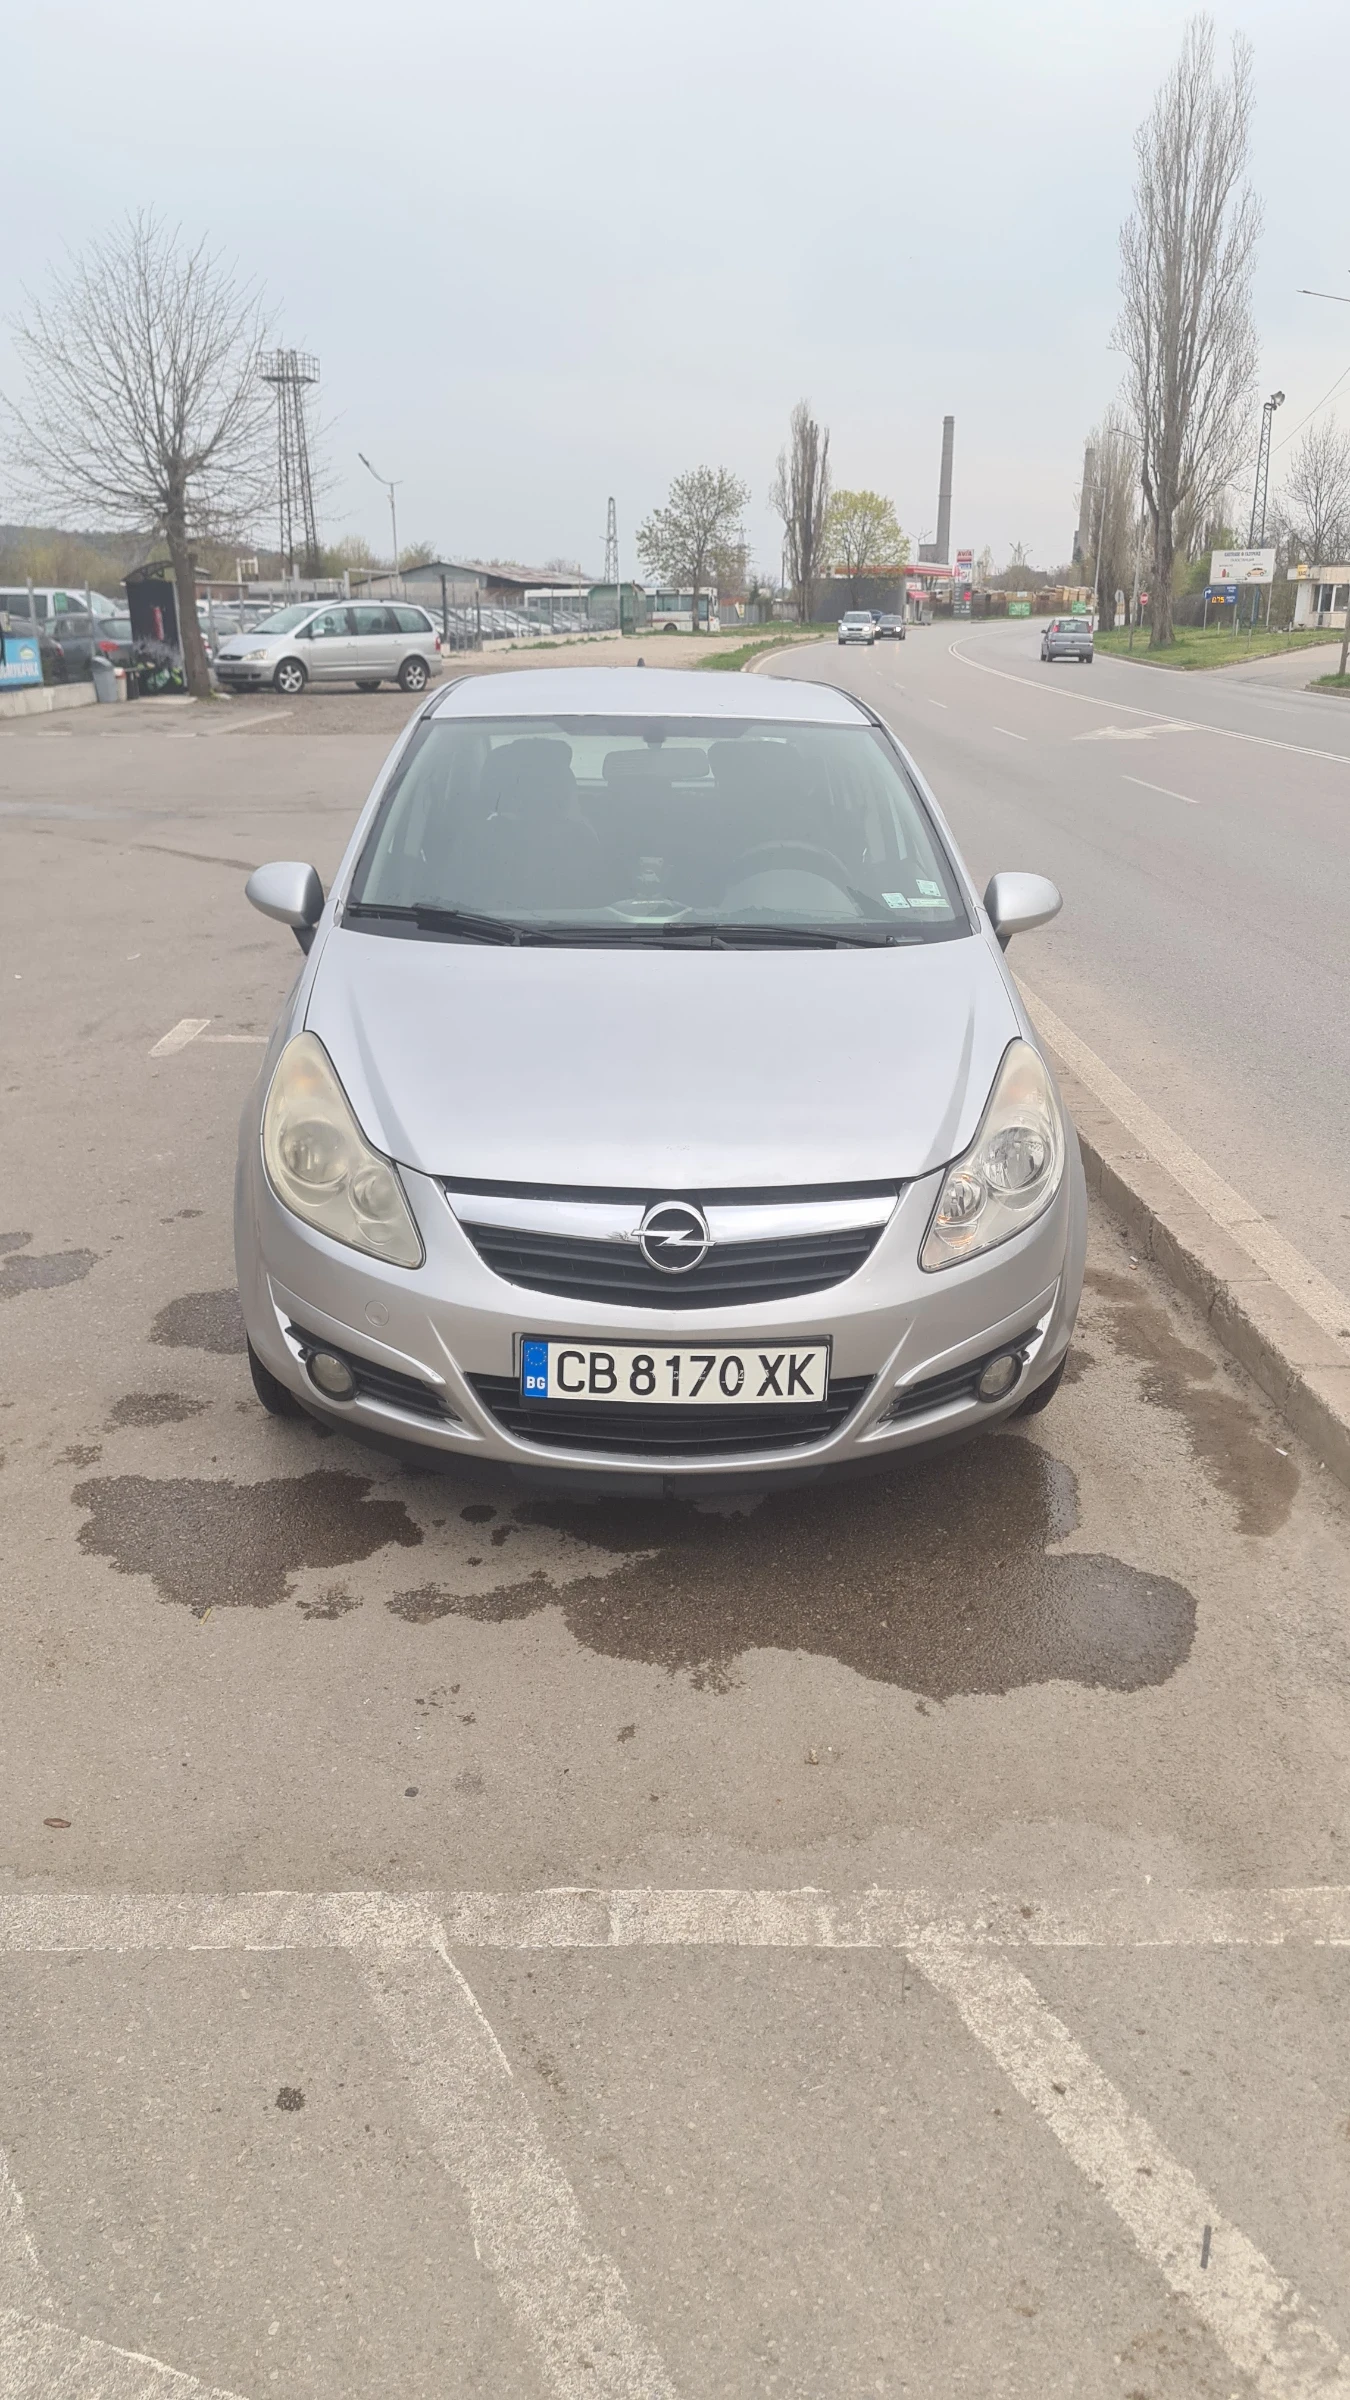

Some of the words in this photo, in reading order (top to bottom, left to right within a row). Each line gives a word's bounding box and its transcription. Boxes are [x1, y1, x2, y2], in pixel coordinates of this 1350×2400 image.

[526, 1375, 546, 1390] BG
[557, 1350, 618, 1394] CB
[629, 1354, 745, 1397] 8170
[756, 1353, 816, 1397] XK
